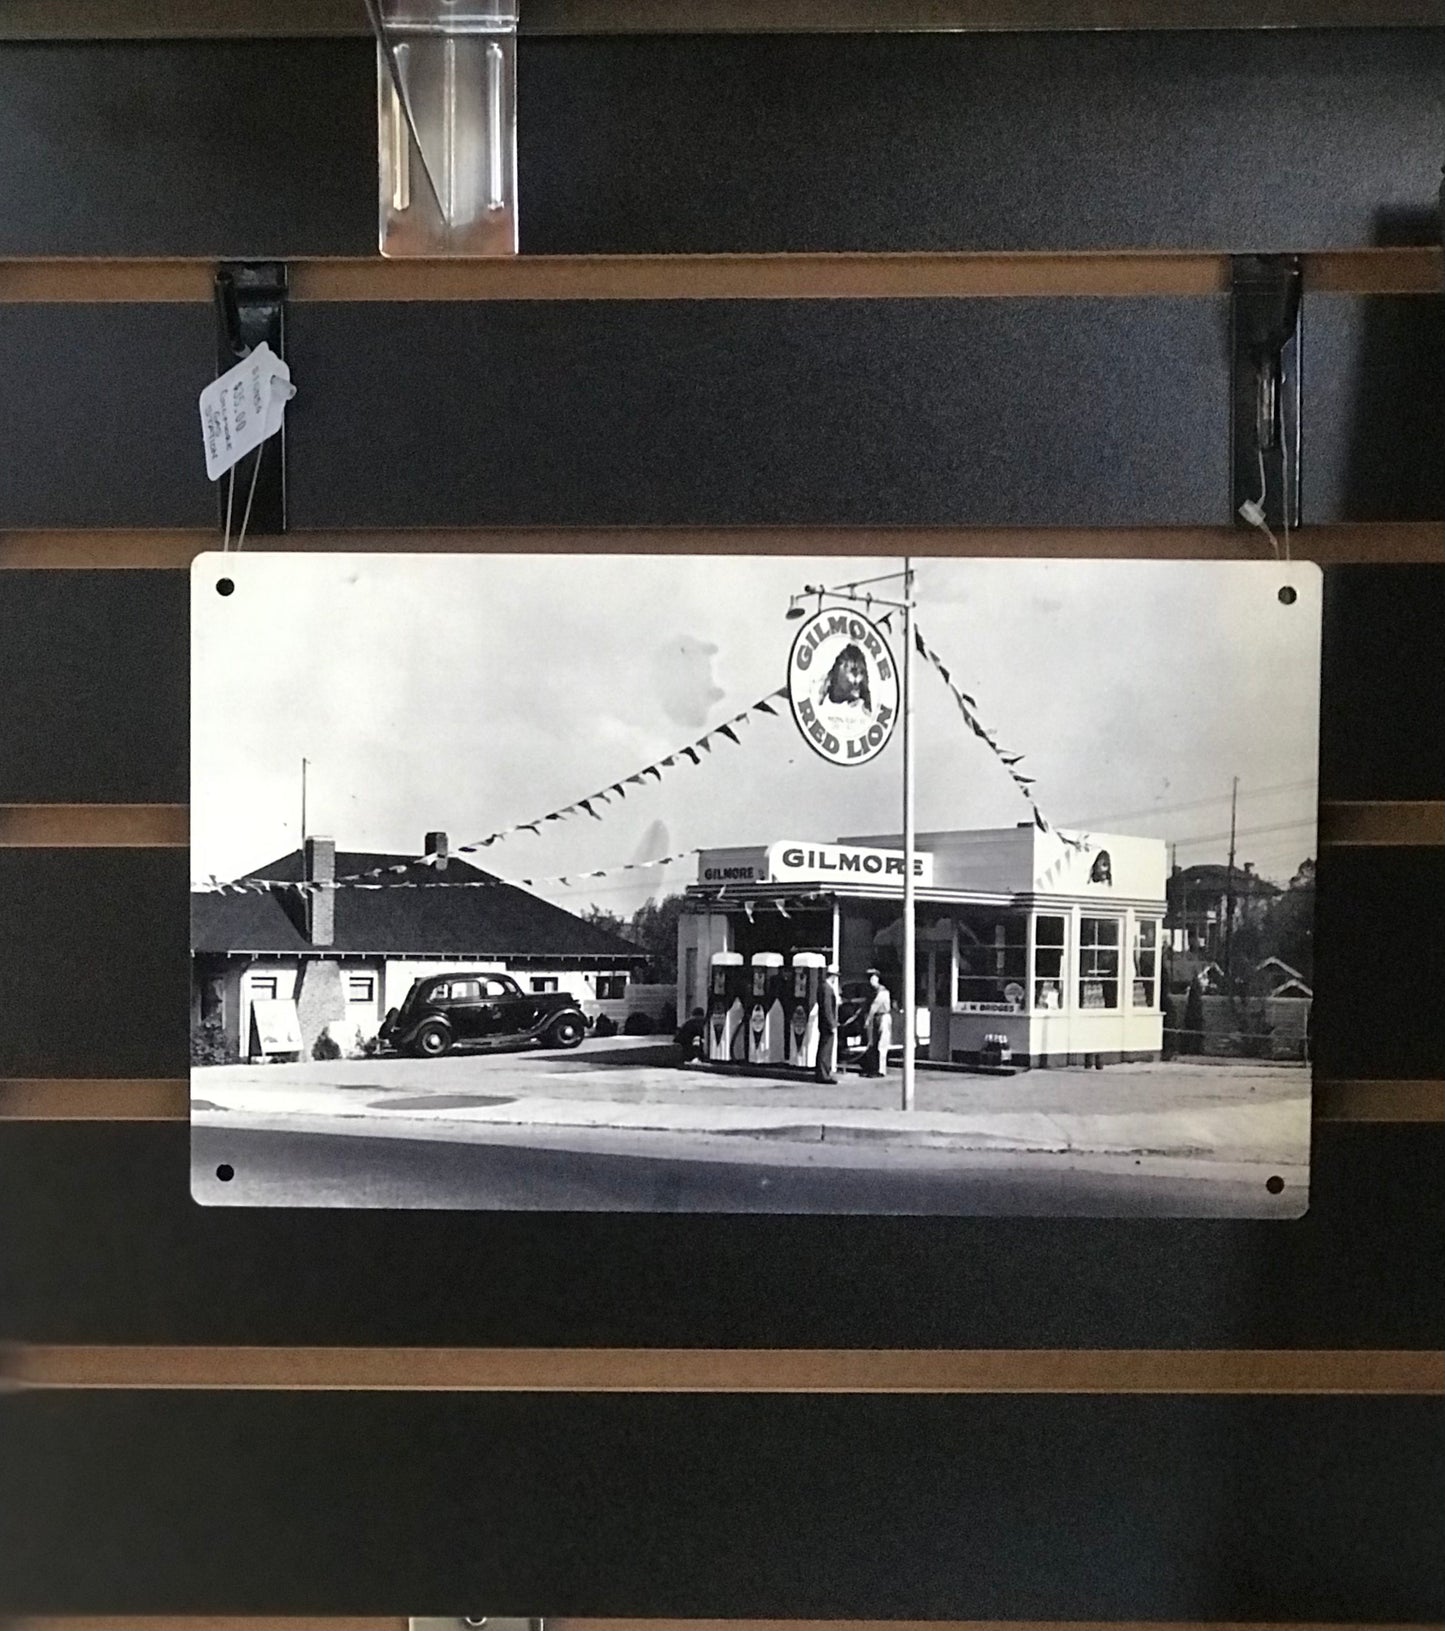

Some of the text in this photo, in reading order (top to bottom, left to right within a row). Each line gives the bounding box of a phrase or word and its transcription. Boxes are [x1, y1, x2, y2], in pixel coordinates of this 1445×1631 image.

[797, 616, 891, 681] GILMORE
[798, 697, 893, 759] RED LION
[704, 866, 754, 880] GILMORE
[782, 849, 924, 876] GILMORE
